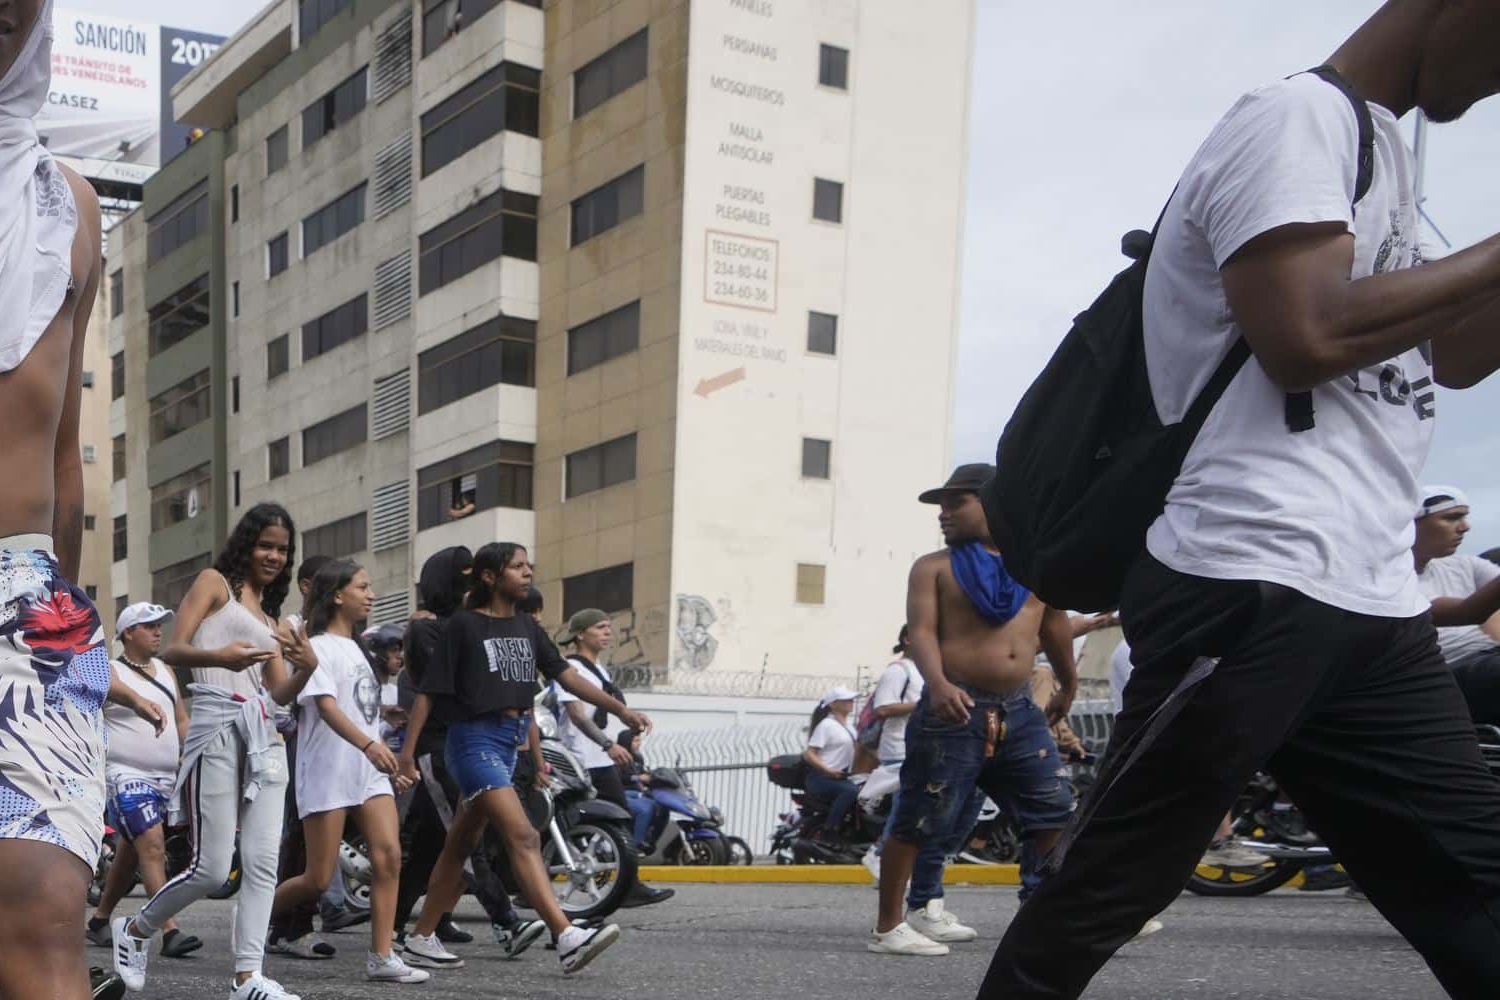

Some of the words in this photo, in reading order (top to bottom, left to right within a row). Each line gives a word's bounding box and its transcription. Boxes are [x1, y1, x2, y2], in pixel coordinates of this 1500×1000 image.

[75, 20, 147, 56] SANCIÓN
[723, 34, 777, 61] PERSIANAS
[171, 37, 219, 66] 201
[65, 55, 117, 73] TRÁNSITO
[71, 69, 148, 89] VENEZOLANOS
[710, 75, 785, 106] MOSQUITEROS
[729, 122, 763, 142] MALLA
[718, 143, 773, 164] ANTISOLAR
[723, 185, 764, 205] PUERTAS
[716, 204, 770, 227] PLEGABLES
[713, 239, 770, 262] TELEFONOS
[490, 637, 533, 660] NEW
